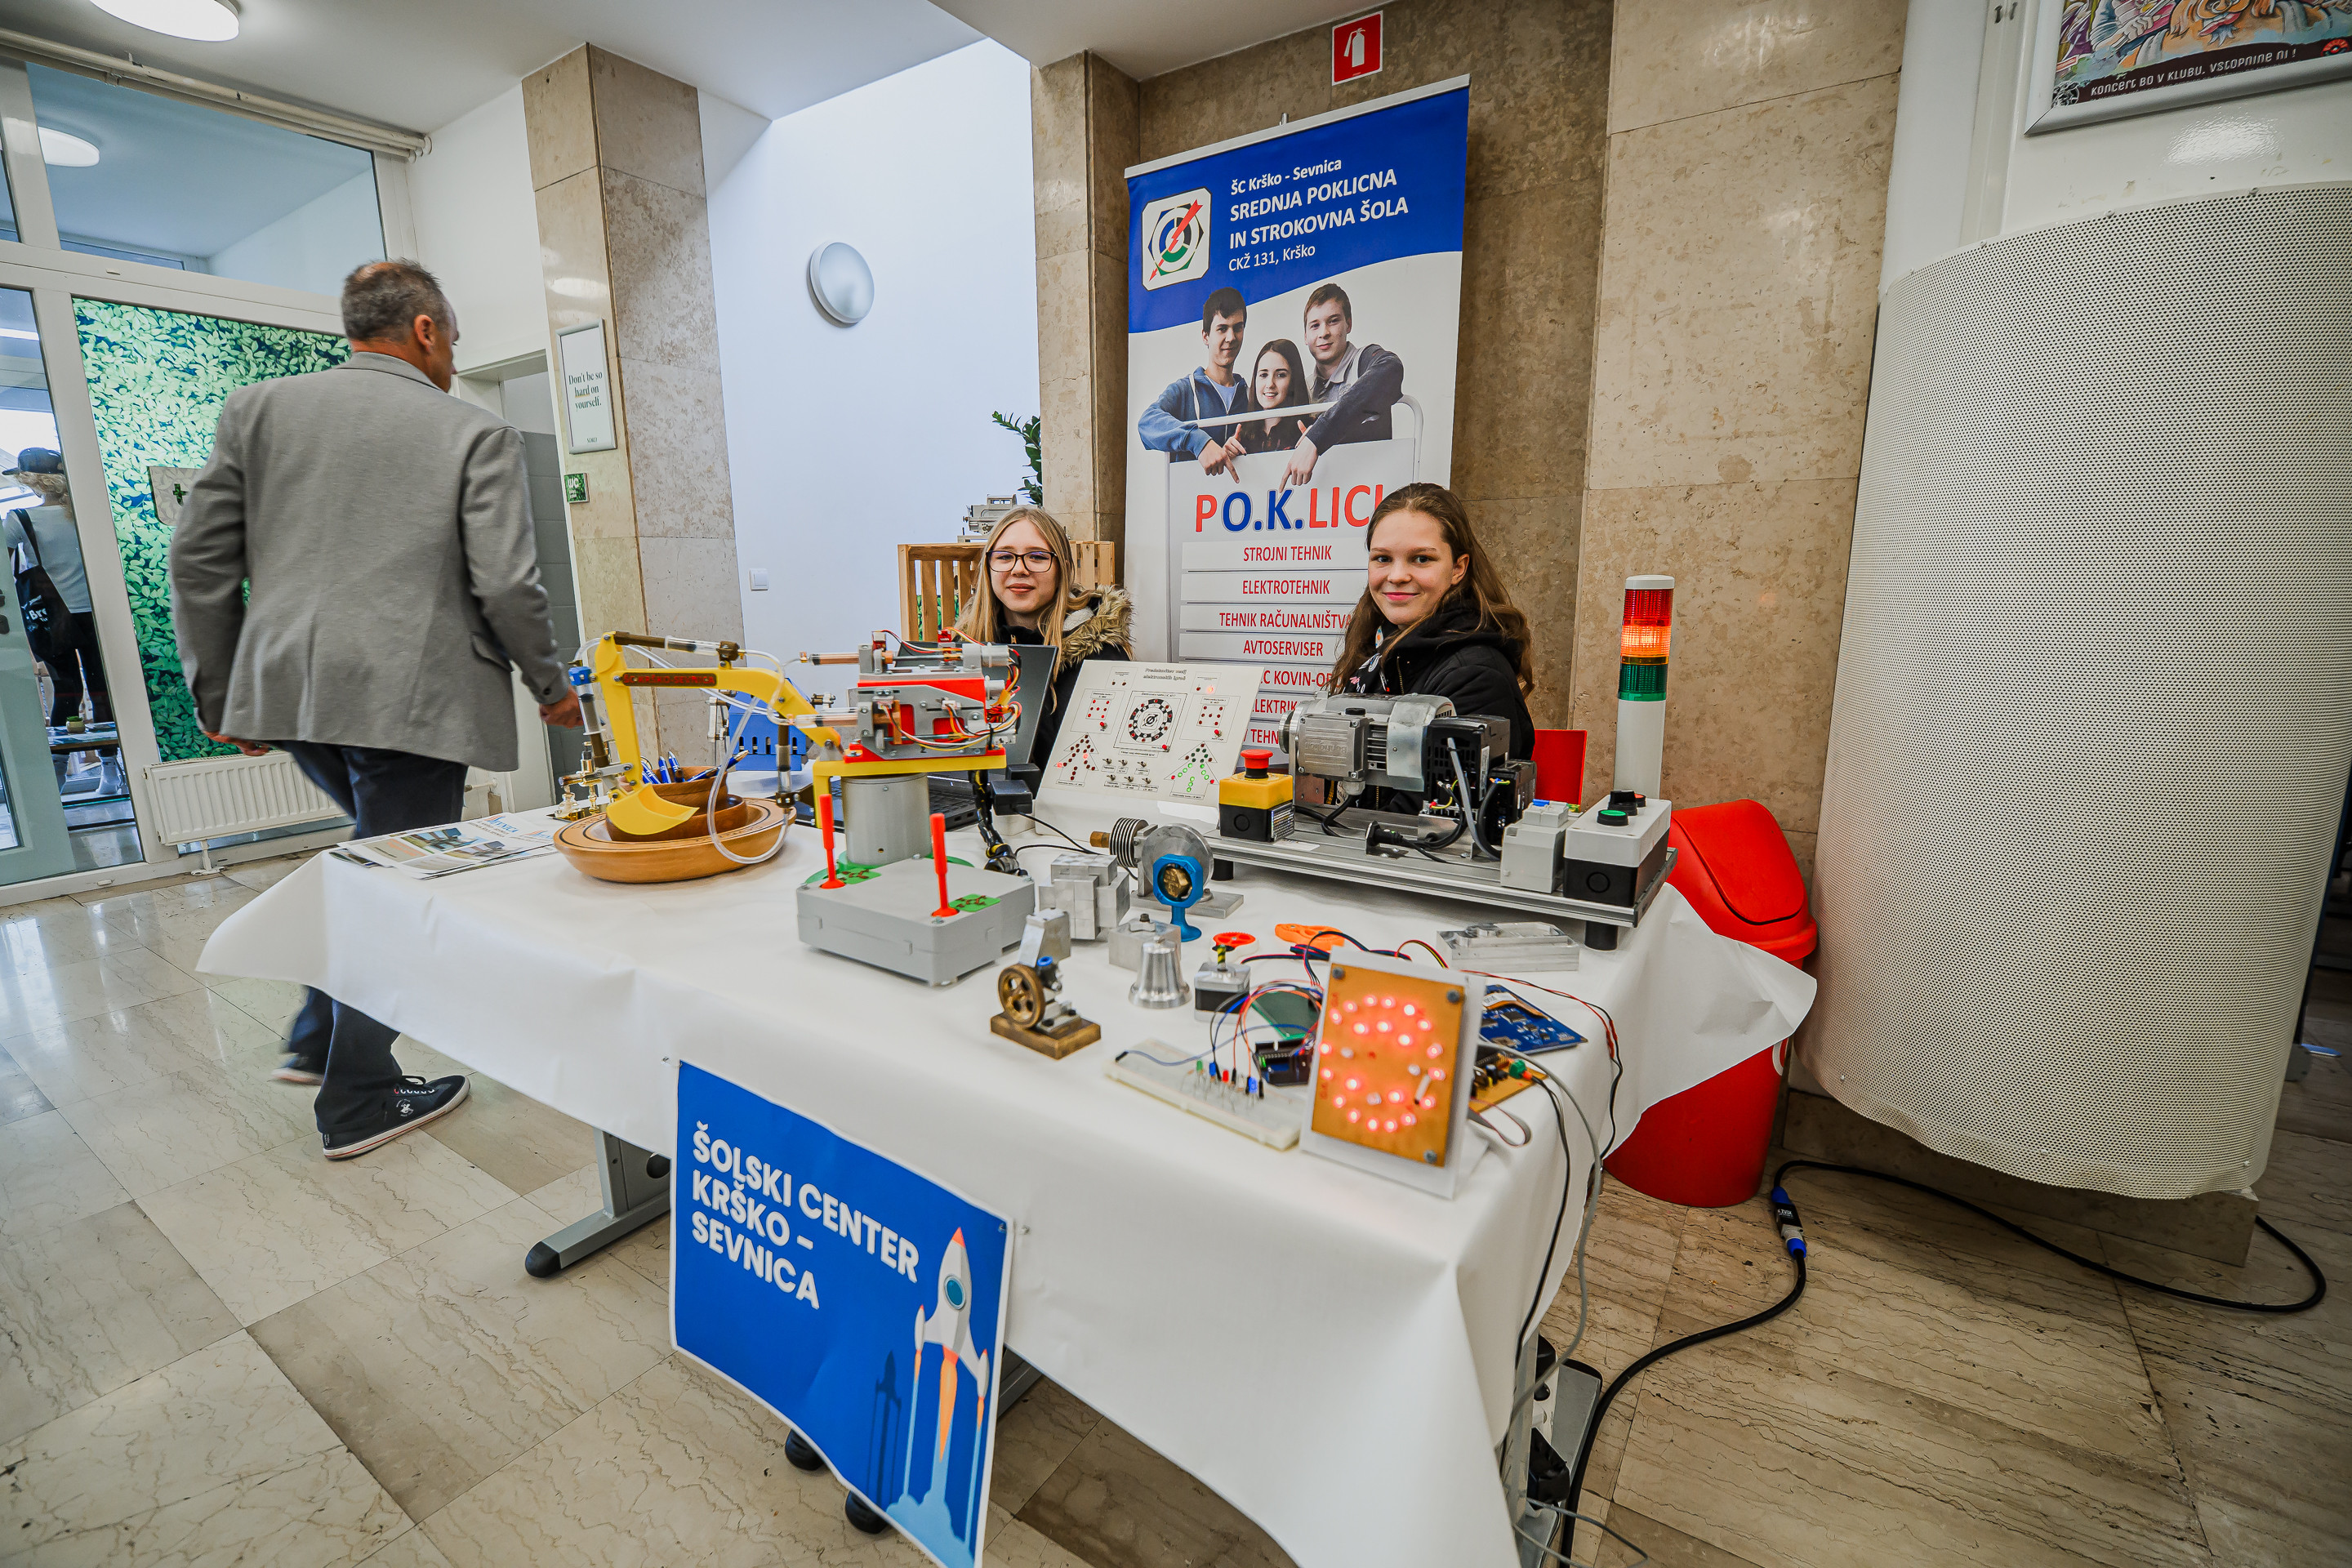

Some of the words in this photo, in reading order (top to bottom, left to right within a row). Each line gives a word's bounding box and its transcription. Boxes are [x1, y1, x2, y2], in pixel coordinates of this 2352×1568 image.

[1231, 179, 1246, 196] ŠC
[1249, 173, 1282, 192] Krško
[1293, 159, 1342, 180] Sevnica
[1230, 190, 1303, 222] SREDNJA
[1307, 168, 1397, 205] POKLICNA
[1229, 230, 1247, 249] IN
[1250, 207, 1356, 245] STROKOVNA
[1360, 197, 1409, 222] ŠOLA
[1228, 253, 1251, 272] CKŽ
[1254, 251, 1279, 267] 131,
[1283, 244, 1316, 261] Krško
[568, 372, 586, 385] Don't
[586, 371, 595, 381] be
[595, 372, 603, 380] so
[574, 384, 590, 397] hard
[590, 385, 599, 394] on
[575, 395, 602, 412] yourself.
[568, 477, 579, 488] WC
[1243, 546, 1288, 561] STROJNI
[1290, 545, 1332, 561] TEHNIK
[1242, 579, 1330, 595] ELEKTROTEHNIK
[1219, 612, 1258, 627] TEHNIK
[1243, 639, 1324, 657] AVTOSERVISER
[1252, 698, 1298, 715] LEKTRIK
[692, 1169, 791, 1247] KRŠKO
[796, 1234, 814, 1250] -
[693, 1120, 792, 1208] ŠOLSKI
[798, 1183, 920, 1284] CENTER
[692, 1210, 820, 1310] SEVNICA
